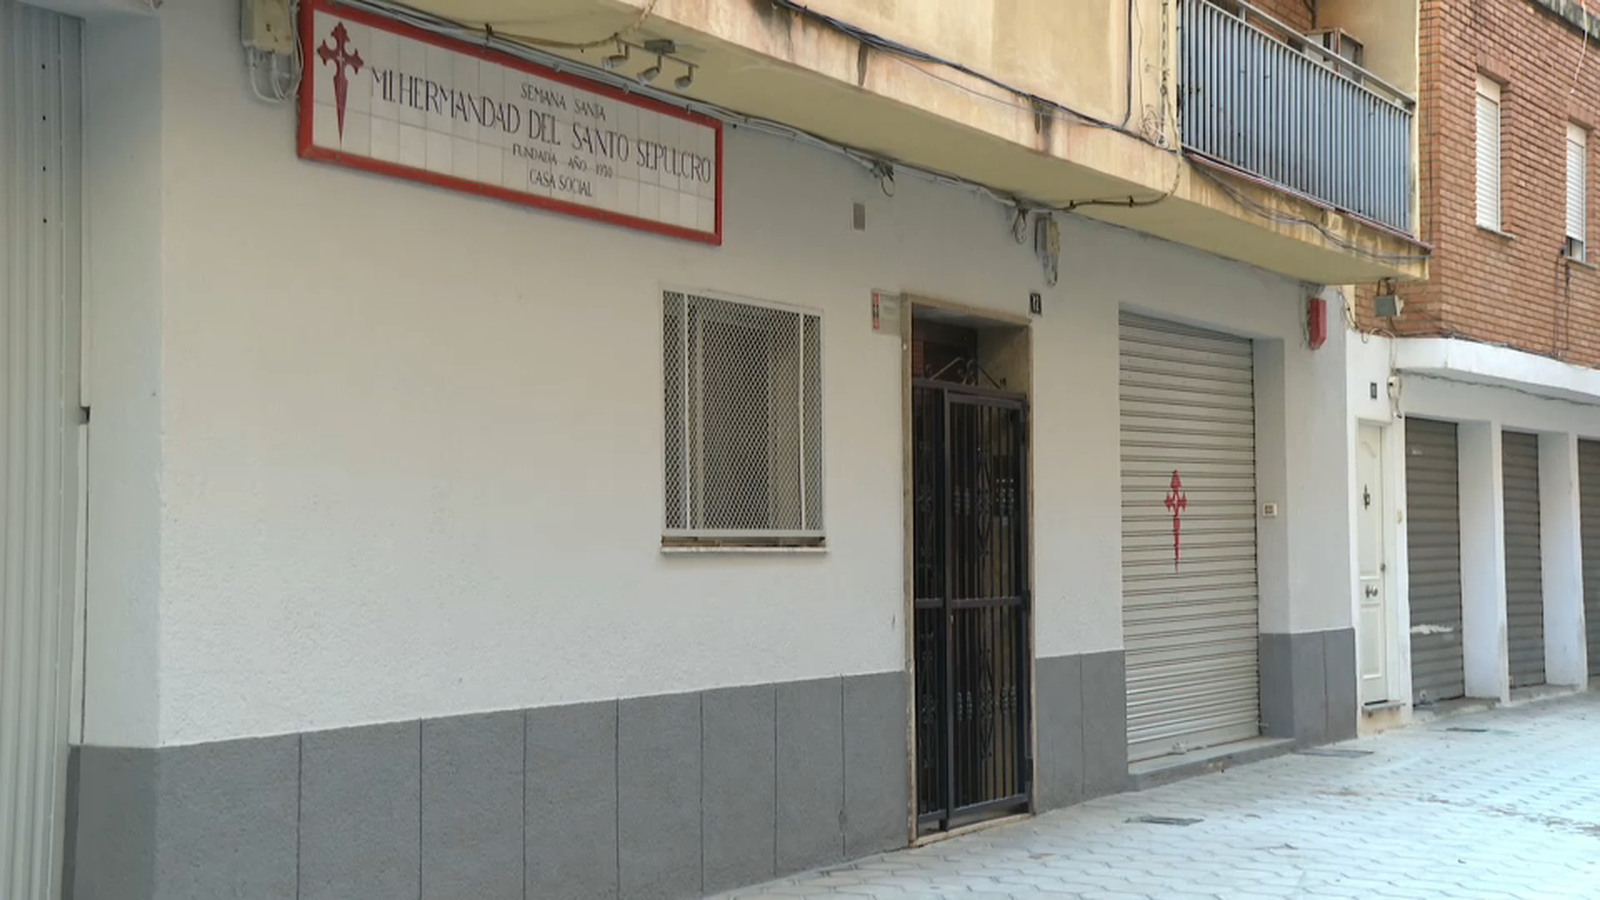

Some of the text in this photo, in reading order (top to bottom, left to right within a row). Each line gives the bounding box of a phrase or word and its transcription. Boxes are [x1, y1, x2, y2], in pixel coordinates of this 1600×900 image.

[520, 81, 606, 121] SEMANA SANTA
[399, 72, 521, 135] HERMANDAD
[529, 108, 561, 146] DEL
[571, 121, 629, 162] SANTO
[636, 138, 712, 184] SEPULCRO
[512, 143, 558, 166] FUNDADA
[529, 168, 593, 197] CASA SOCIAL
